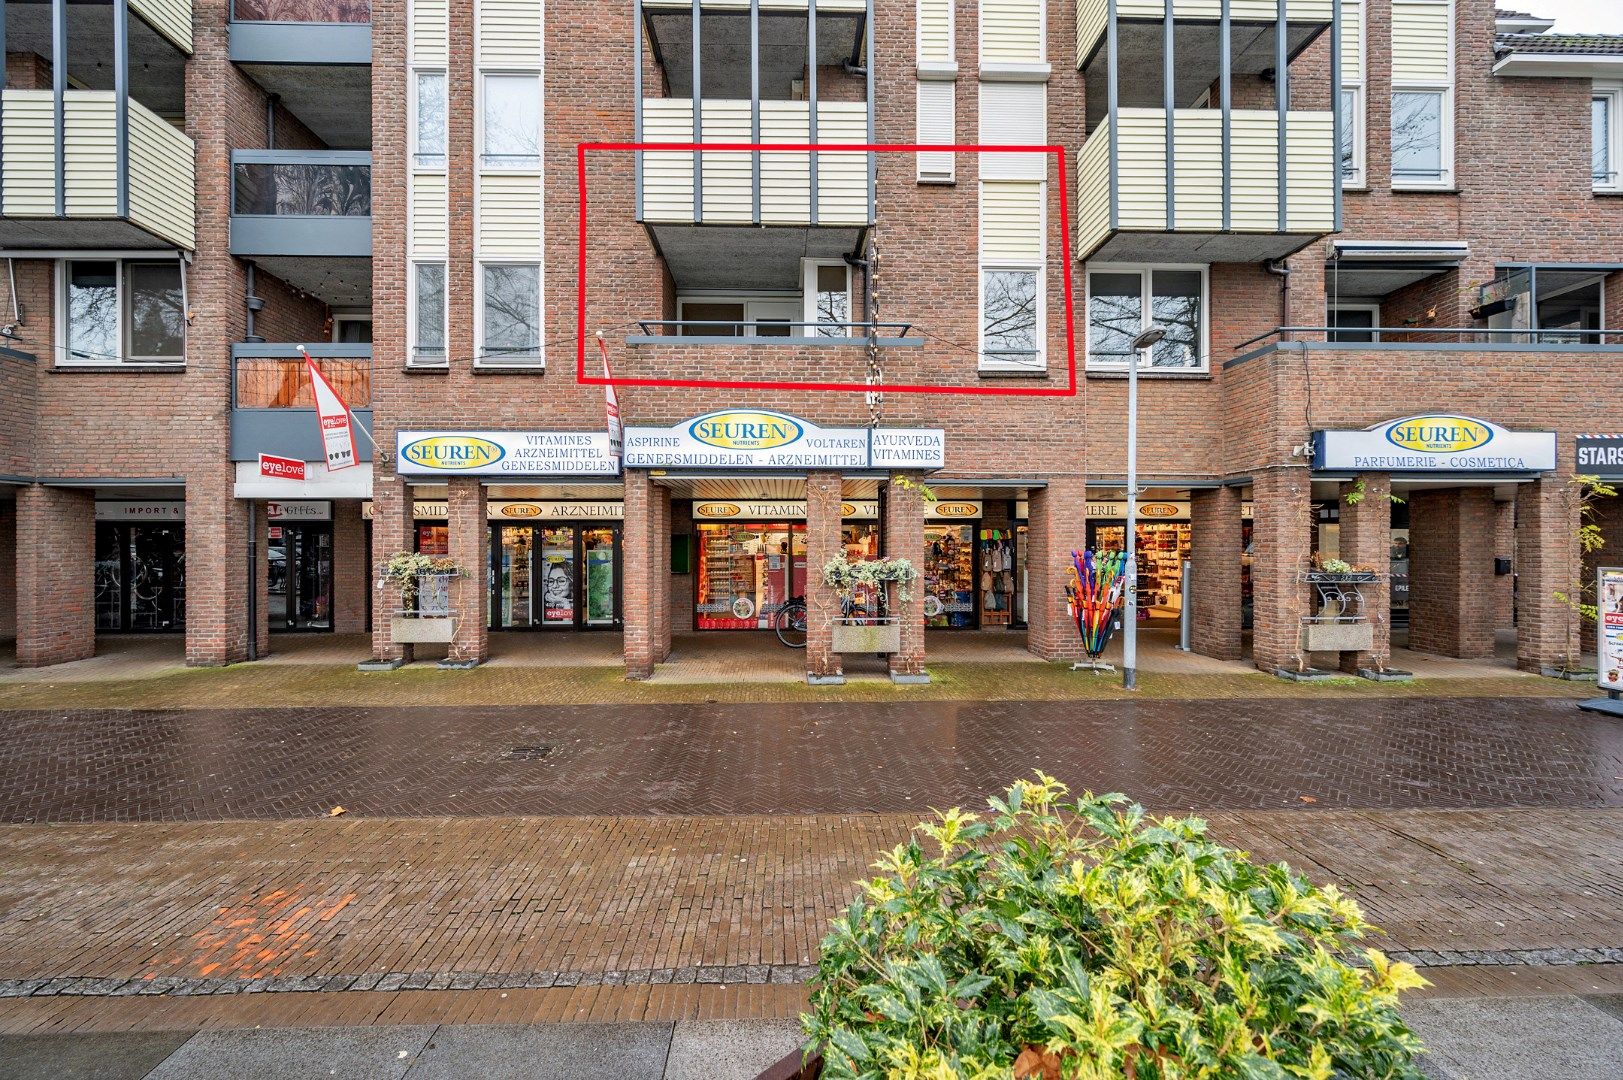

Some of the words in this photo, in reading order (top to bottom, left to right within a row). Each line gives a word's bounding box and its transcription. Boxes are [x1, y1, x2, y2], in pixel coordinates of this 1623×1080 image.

[323, 415, 348, 427] eyelove
[525, 435, 593, 446] VITAMINES
[626, 437, 681, 447] ASPIRINE
[805, 438, 866, 448] VOLTAREN
[872, 434, 942, 447] AYURVEDA
[514, 448, 604, 458] ARZNEIMITTEL
[873, 448, 941, 460] VITAMINES
[1578, 446, 1623, 465] STARS
[626, 453, 754, 465] GENEESMIDDELEN
[768, 454, 866, 466] ARZNEIMITTEL
[1354, 456, 1437, 467] PARFUMERIE
[1450, 457, 1526, 468] COSMETICA
[262, 461, 304, 475] eyelove
[501, 460, 616, 471] GENEESMIDDELEN
[124, 507, 167, 515] IMPORT
[504, 506, 538, 515] SEUREN
[700, 506, 736, 514] SEUREN
[748, 505, 807, 516] VITAMIN
[939, 506, 974, 514] SEUREN
[1142, 506, 1173, 514] SEUREN
